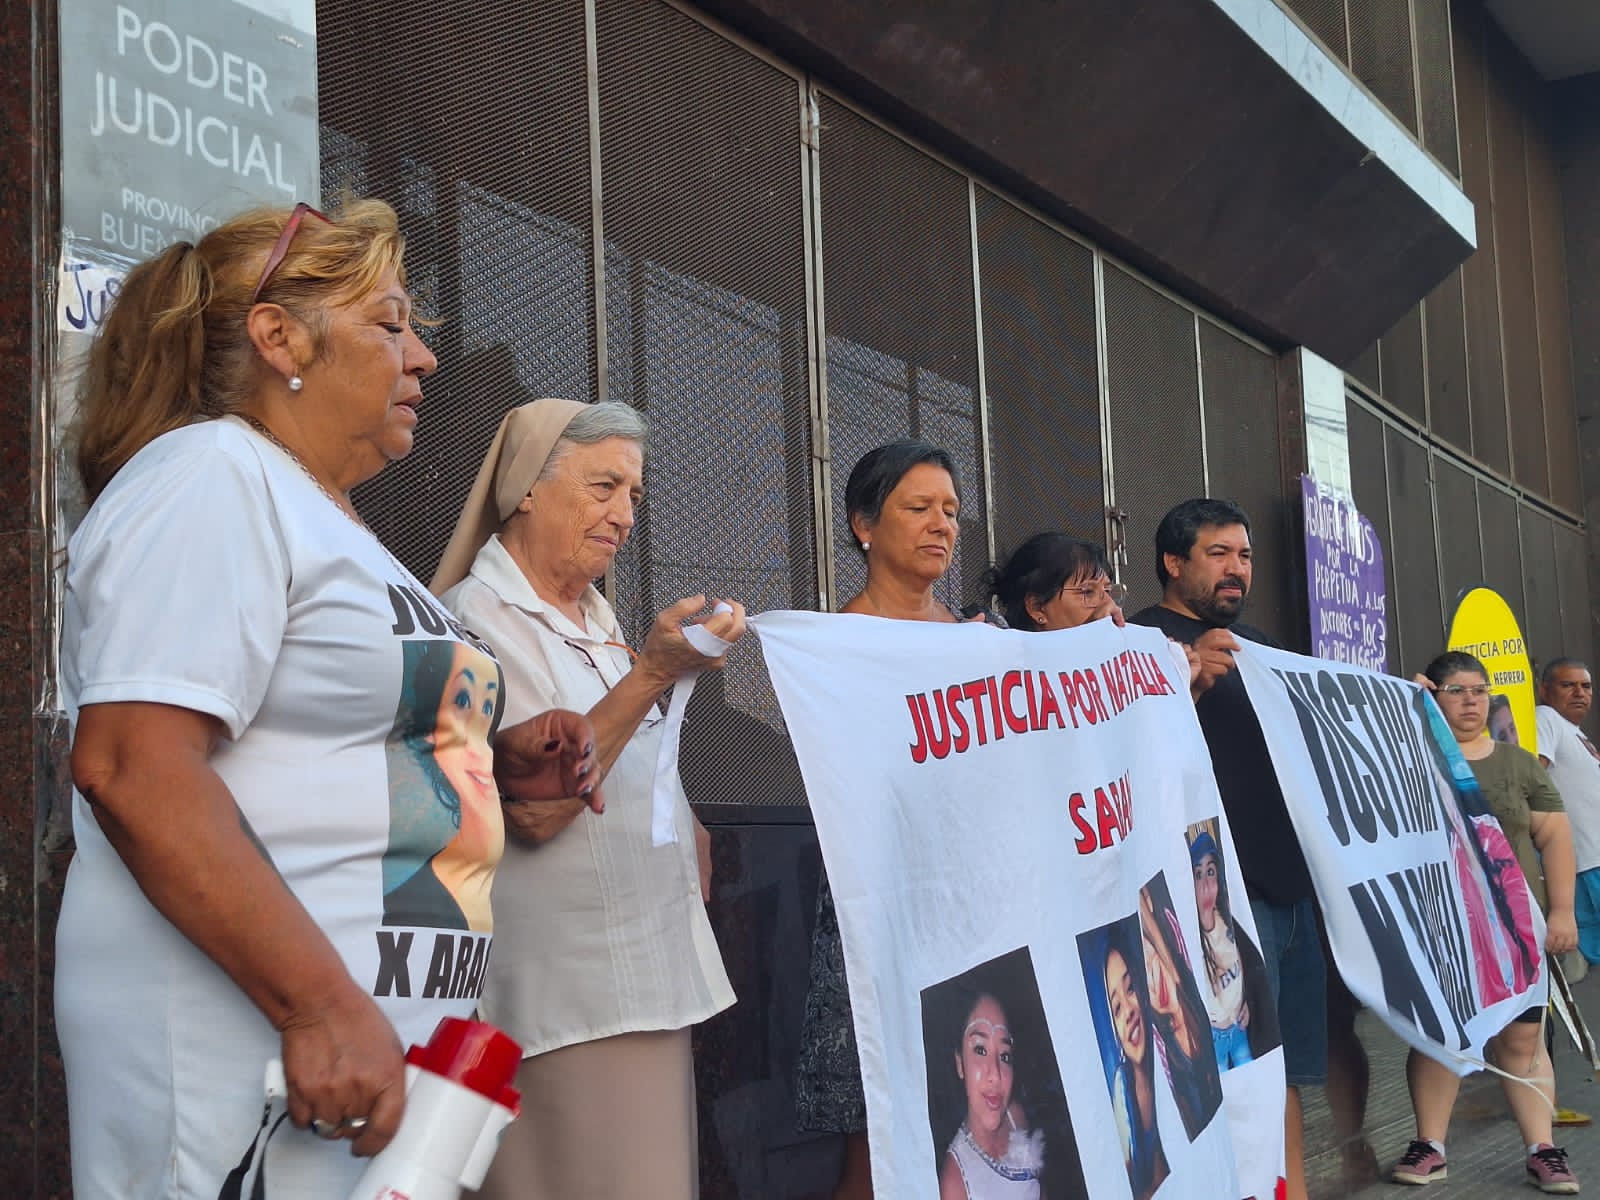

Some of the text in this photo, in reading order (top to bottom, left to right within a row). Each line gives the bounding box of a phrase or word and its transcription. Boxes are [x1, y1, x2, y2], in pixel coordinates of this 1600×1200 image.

[117, 5, 273, 117] PODER
[91, 71, 297, 198] JUDICIAL
[122, 187, 218, 236] PROVINC
[1326, 543, 1360, 578] POR LA
[1493, 671, 1526, 687] HERRERA
[1502, 638, 1524, 655] POR
[904, 649, 1176, 764] JUSTICIA POR NATALIA
[1270, 667, 1438, 847] JUSTICIA
[374, 930, 415, 998] X
